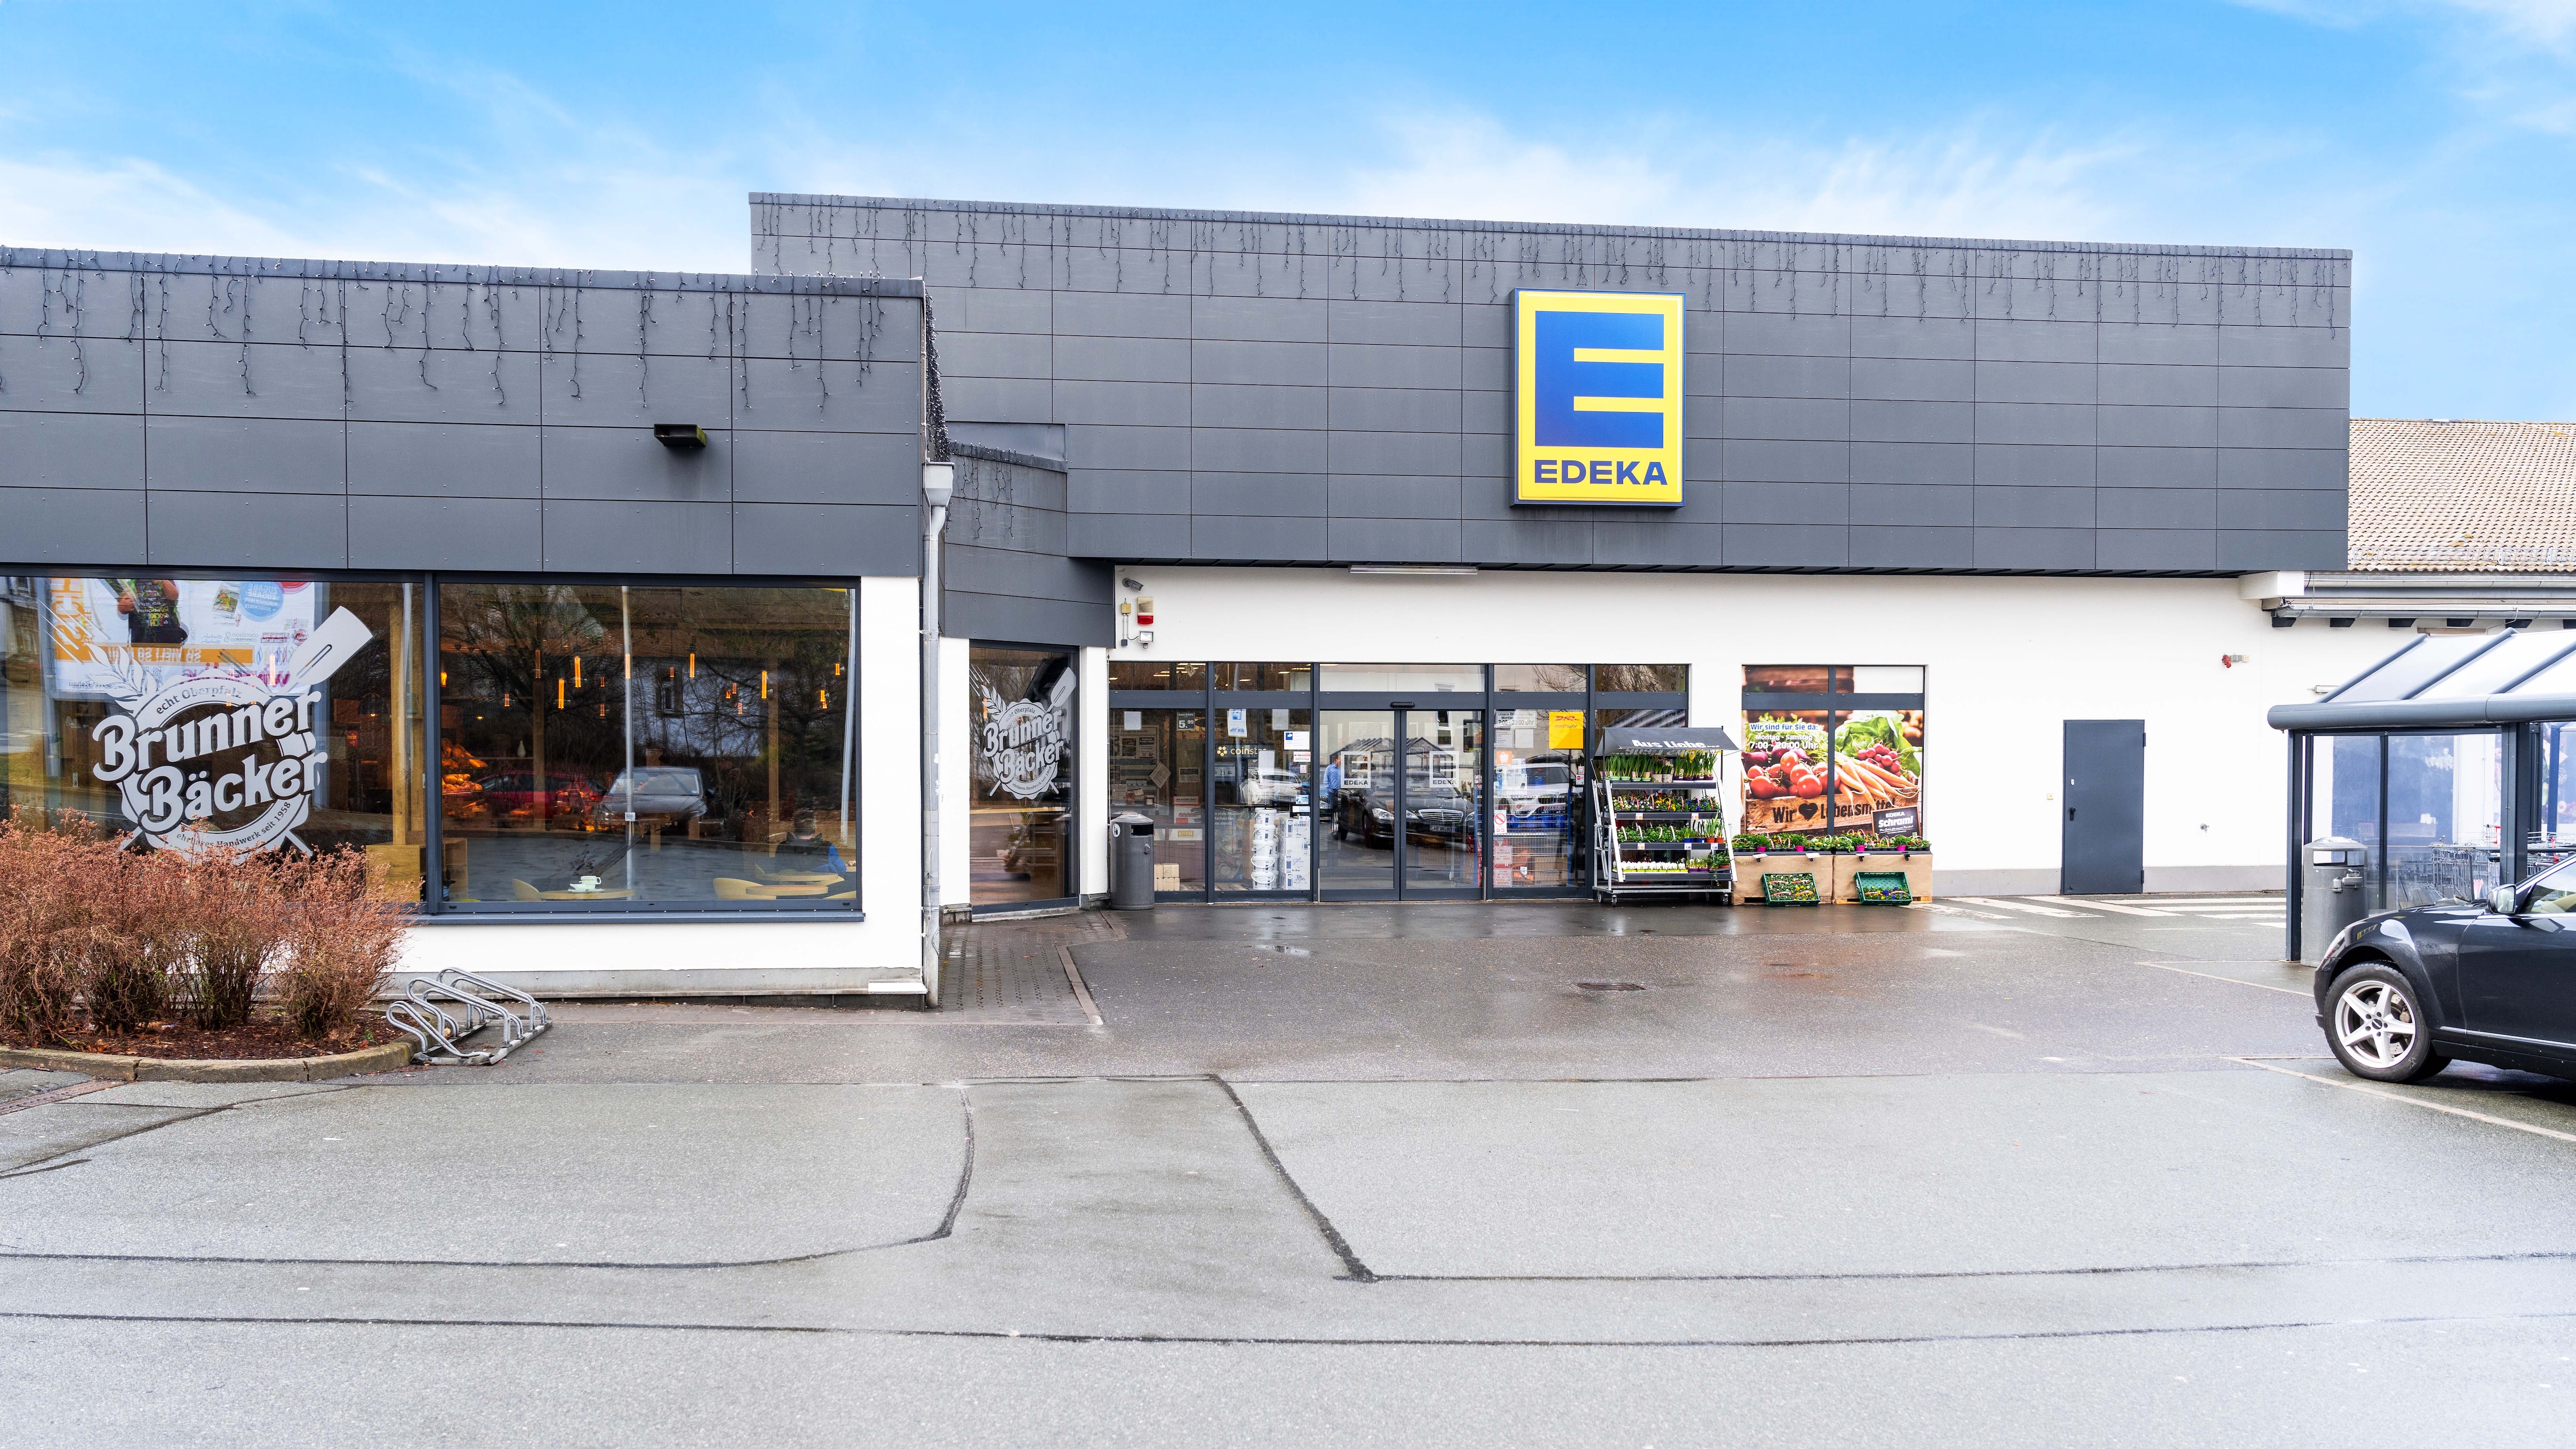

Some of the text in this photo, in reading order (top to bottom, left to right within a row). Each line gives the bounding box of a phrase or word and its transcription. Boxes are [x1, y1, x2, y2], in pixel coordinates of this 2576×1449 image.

[1535, 311, 1664, 448] E
[1535, 460, 1668, 485] EDEKA
[156, 686, 243, 715] echt Oberpfalz
[92, 691, 322, 781] Brunner
[983, 710, 1062, 757] Brunner
[1632, 739, 1720, 748] Aus Liebe...
[1230, 747, 1267, 755] coinst
[141, 751, 328, 832] Bäcker
[216, 831, 261, 847] Handwerk
[261, 821, 276, 834] seit
[274, 801, 291, 822] 1958
[1772, 798, 1895, 823] Wir Lbensmttel
[1878, 816, 1913, 828] Schraml
